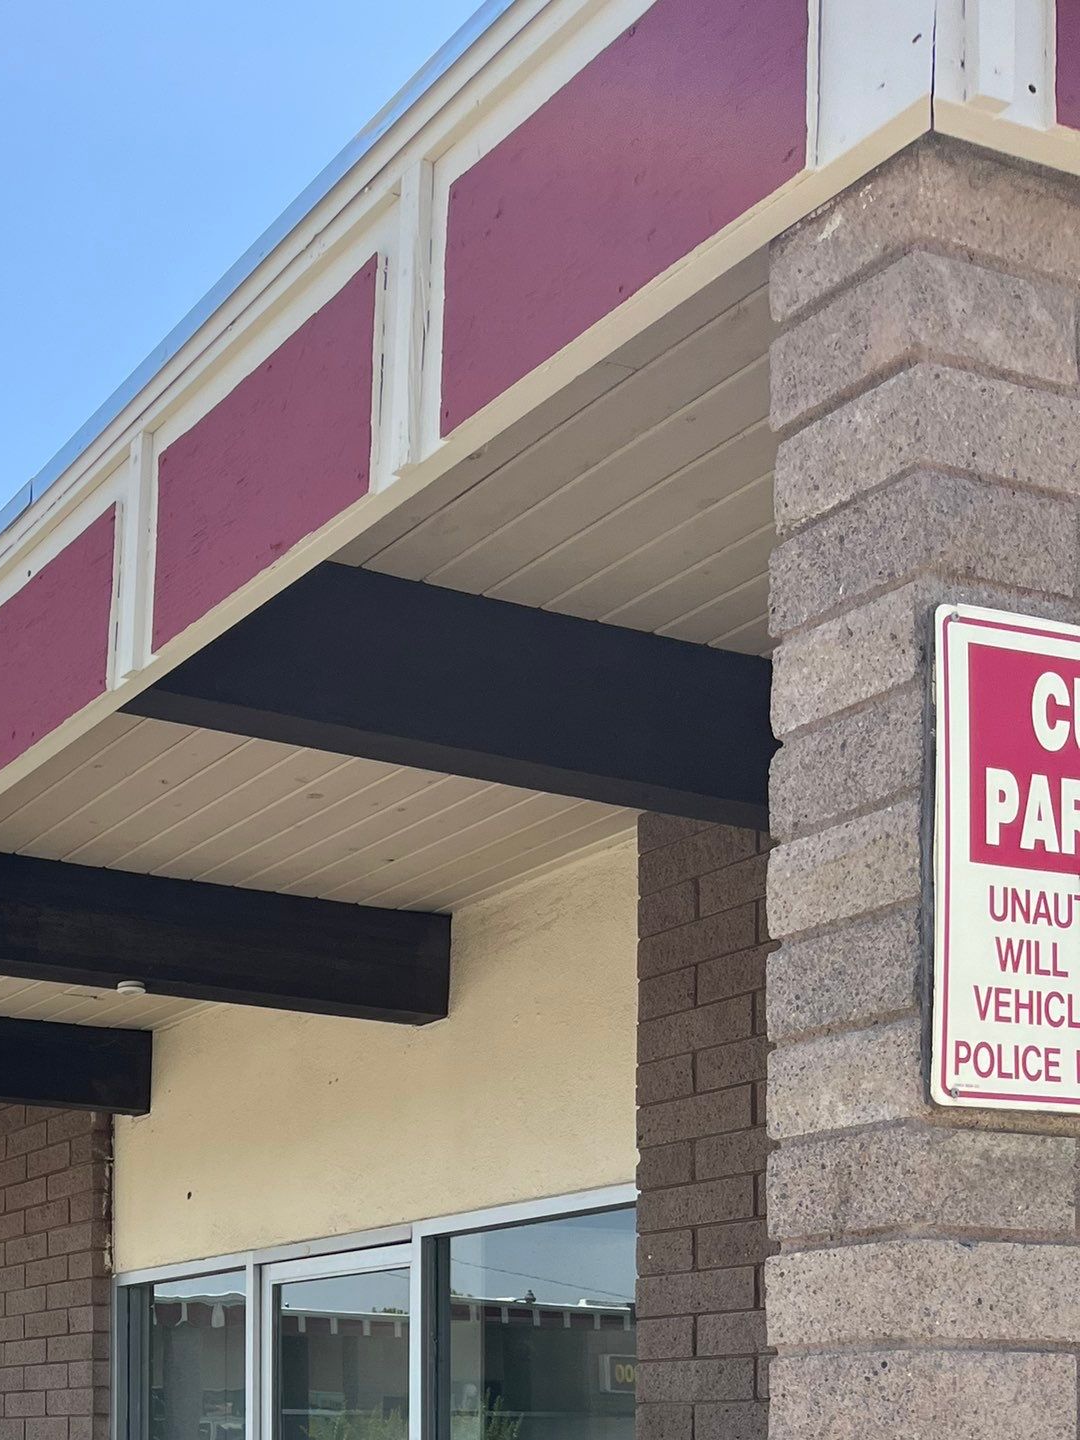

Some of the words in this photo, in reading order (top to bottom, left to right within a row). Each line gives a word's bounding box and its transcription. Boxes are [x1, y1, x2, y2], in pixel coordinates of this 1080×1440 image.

[1031, 671, 1080, 752] C
[995, 936, 1069, 978] WILL
[973, 985, 1080, 1029] VEHICL
[954, 1040, 1062, 1082] POLICE
